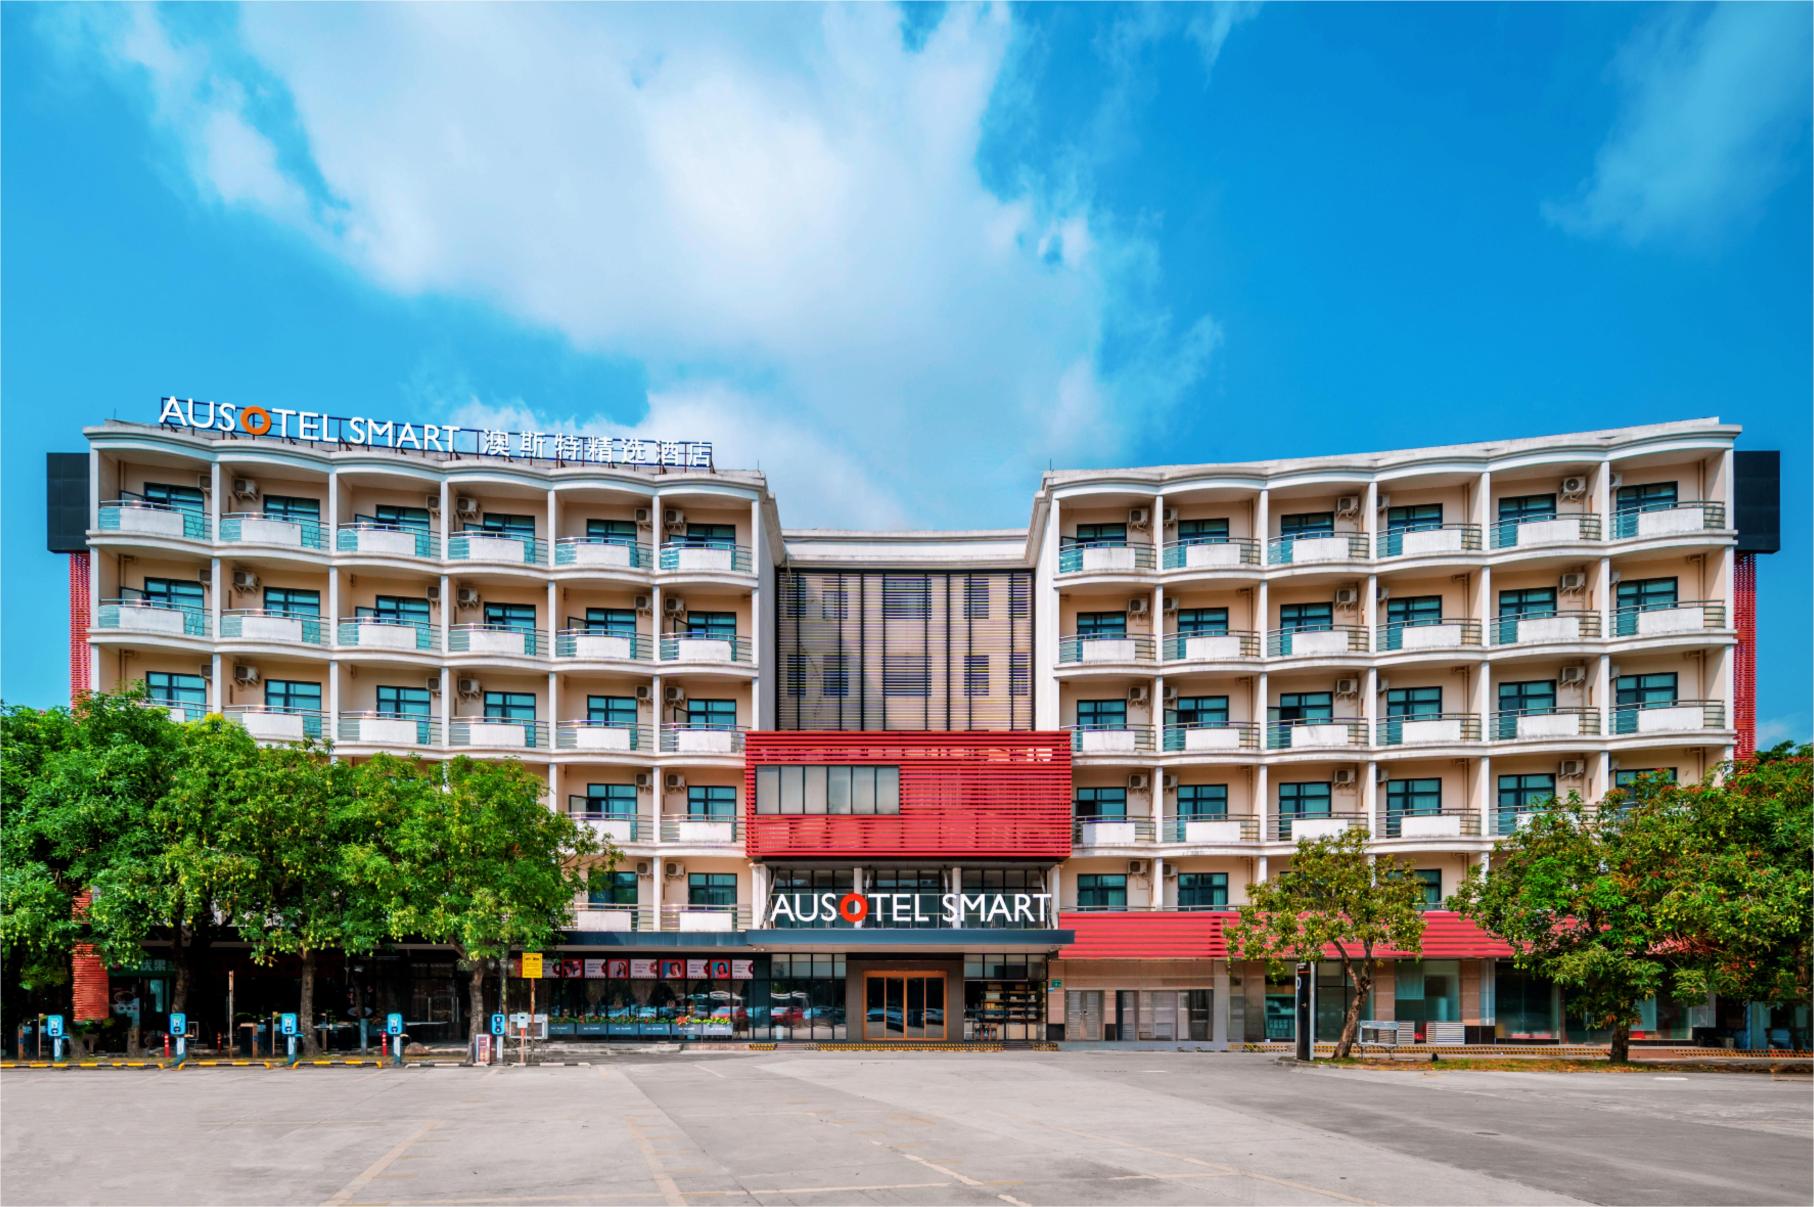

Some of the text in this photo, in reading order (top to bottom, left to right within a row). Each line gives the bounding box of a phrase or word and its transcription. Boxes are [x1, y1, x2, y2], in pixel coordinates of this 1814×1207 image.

[159, 396, 460, 453] AUSOTEL SMART
[481, 429, 713, 467] 澳斯特精选酒店
[770, 892, 1052, 923] AUSOTEL SMART
